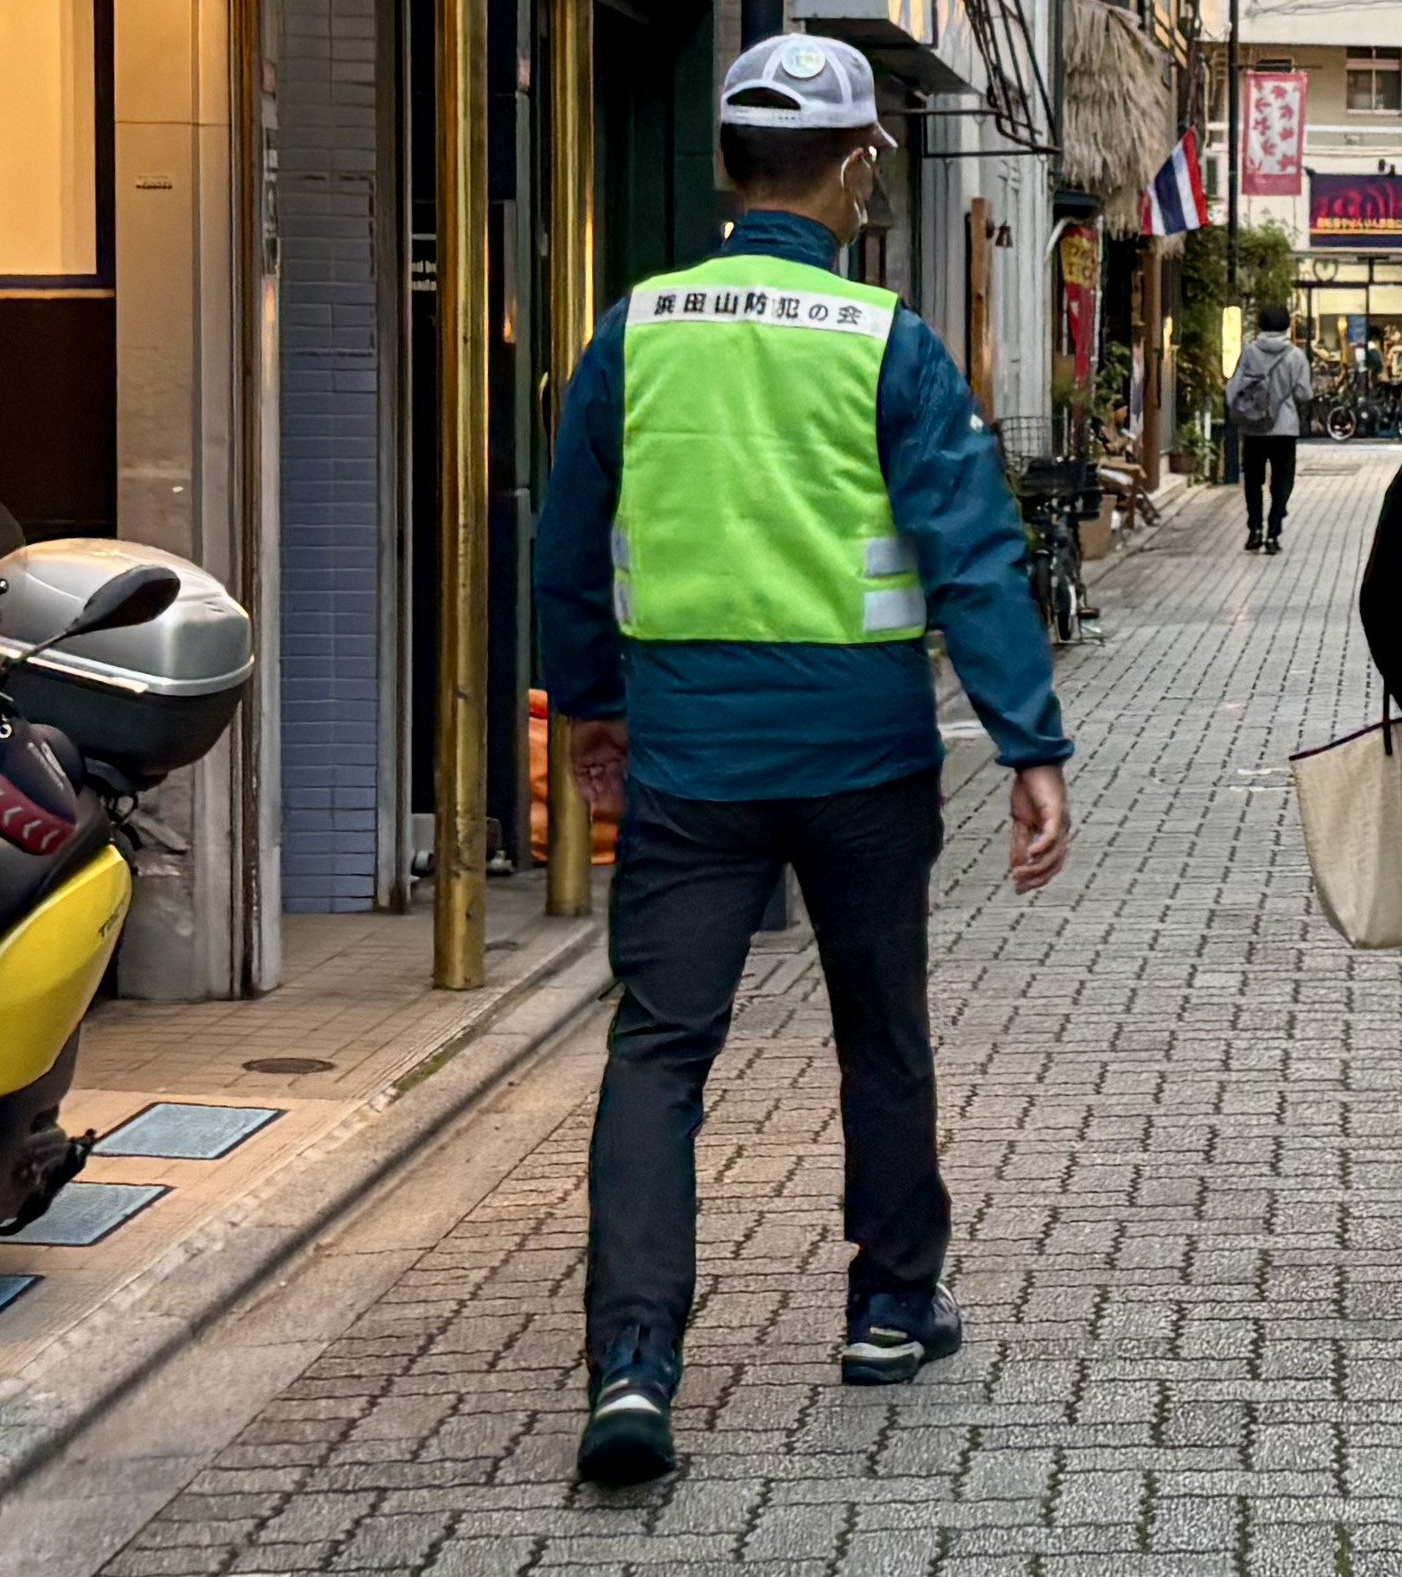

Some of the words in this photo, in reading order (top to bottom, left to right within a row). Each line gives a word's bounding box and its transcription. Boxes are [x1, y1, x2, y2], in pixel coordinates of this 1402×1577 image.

[653, 291, 863, 325] 浜田山防犯の会
